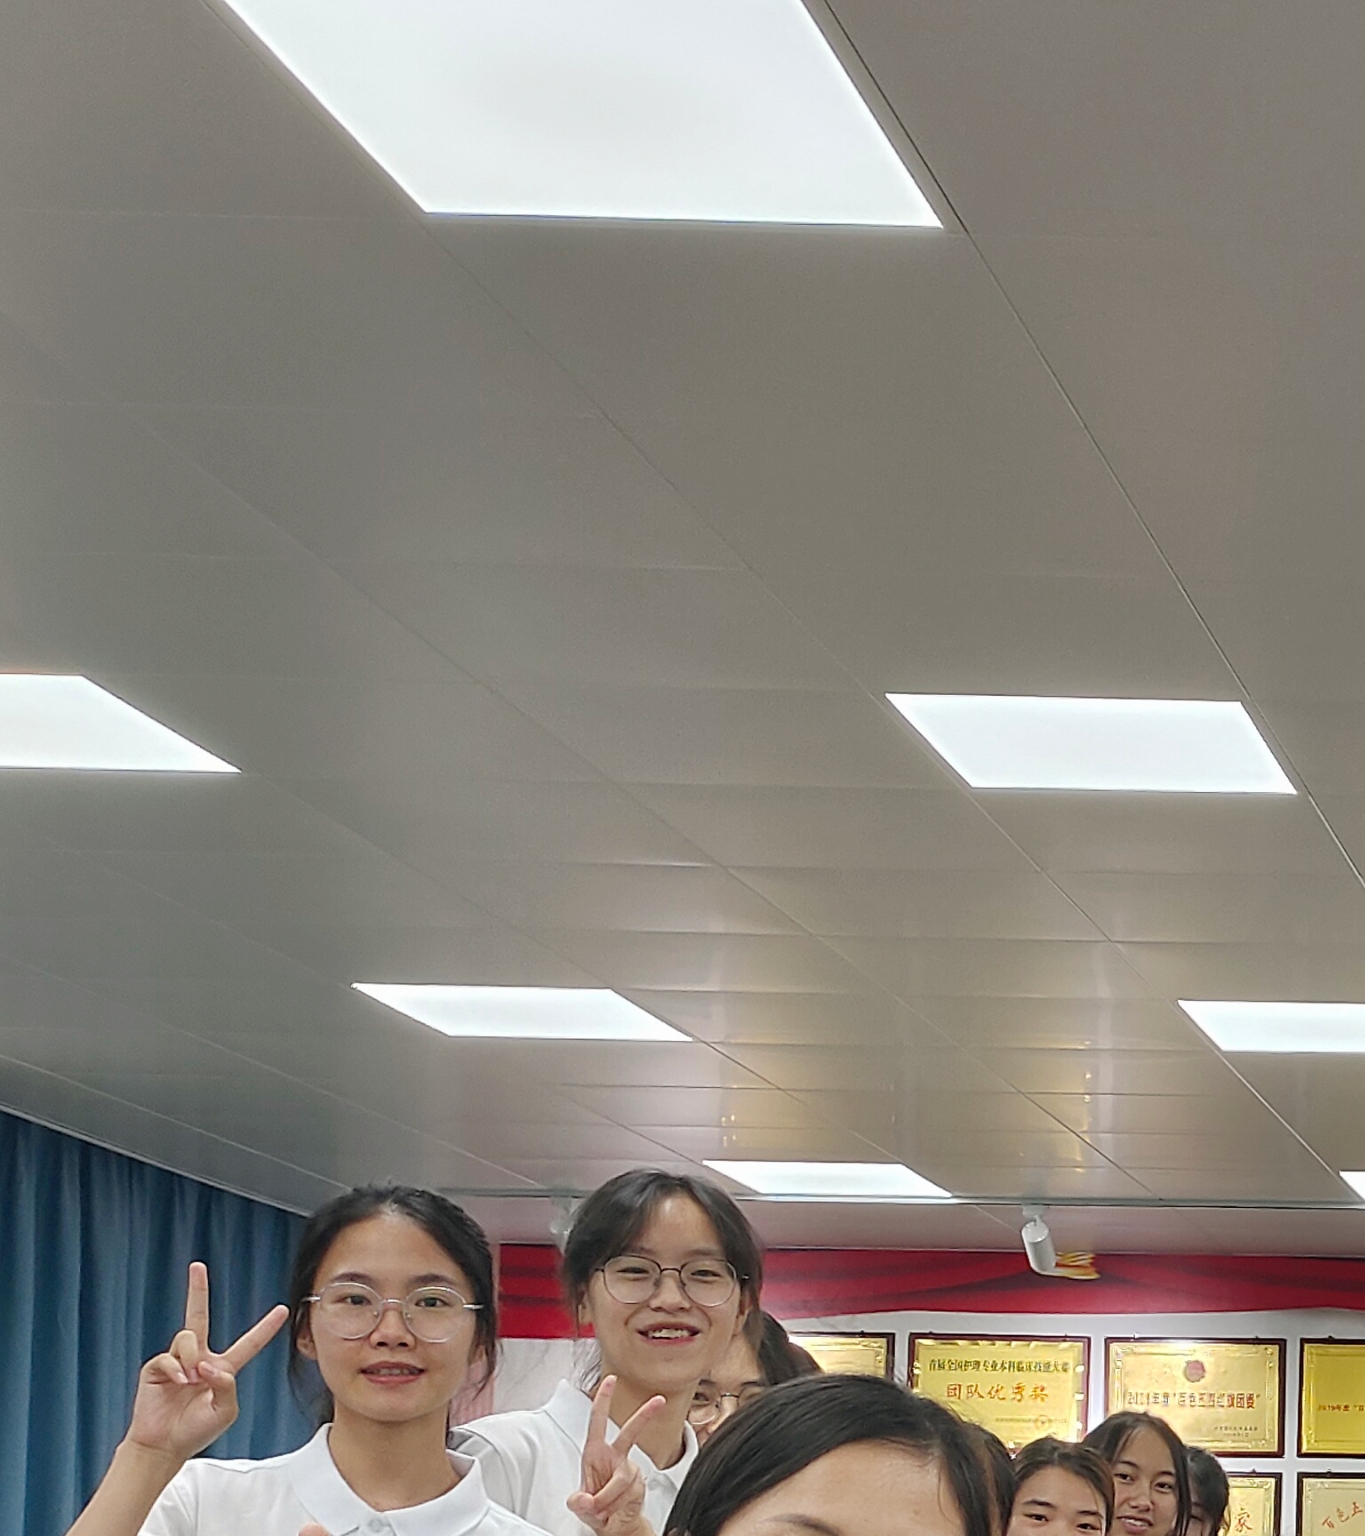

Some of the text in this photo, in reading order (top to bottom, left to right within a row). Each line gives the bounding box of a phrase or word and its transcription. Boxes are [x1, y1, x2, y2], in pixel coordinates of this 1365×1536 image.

[946, 1381, 1049, 1403] 团队优秀奖
